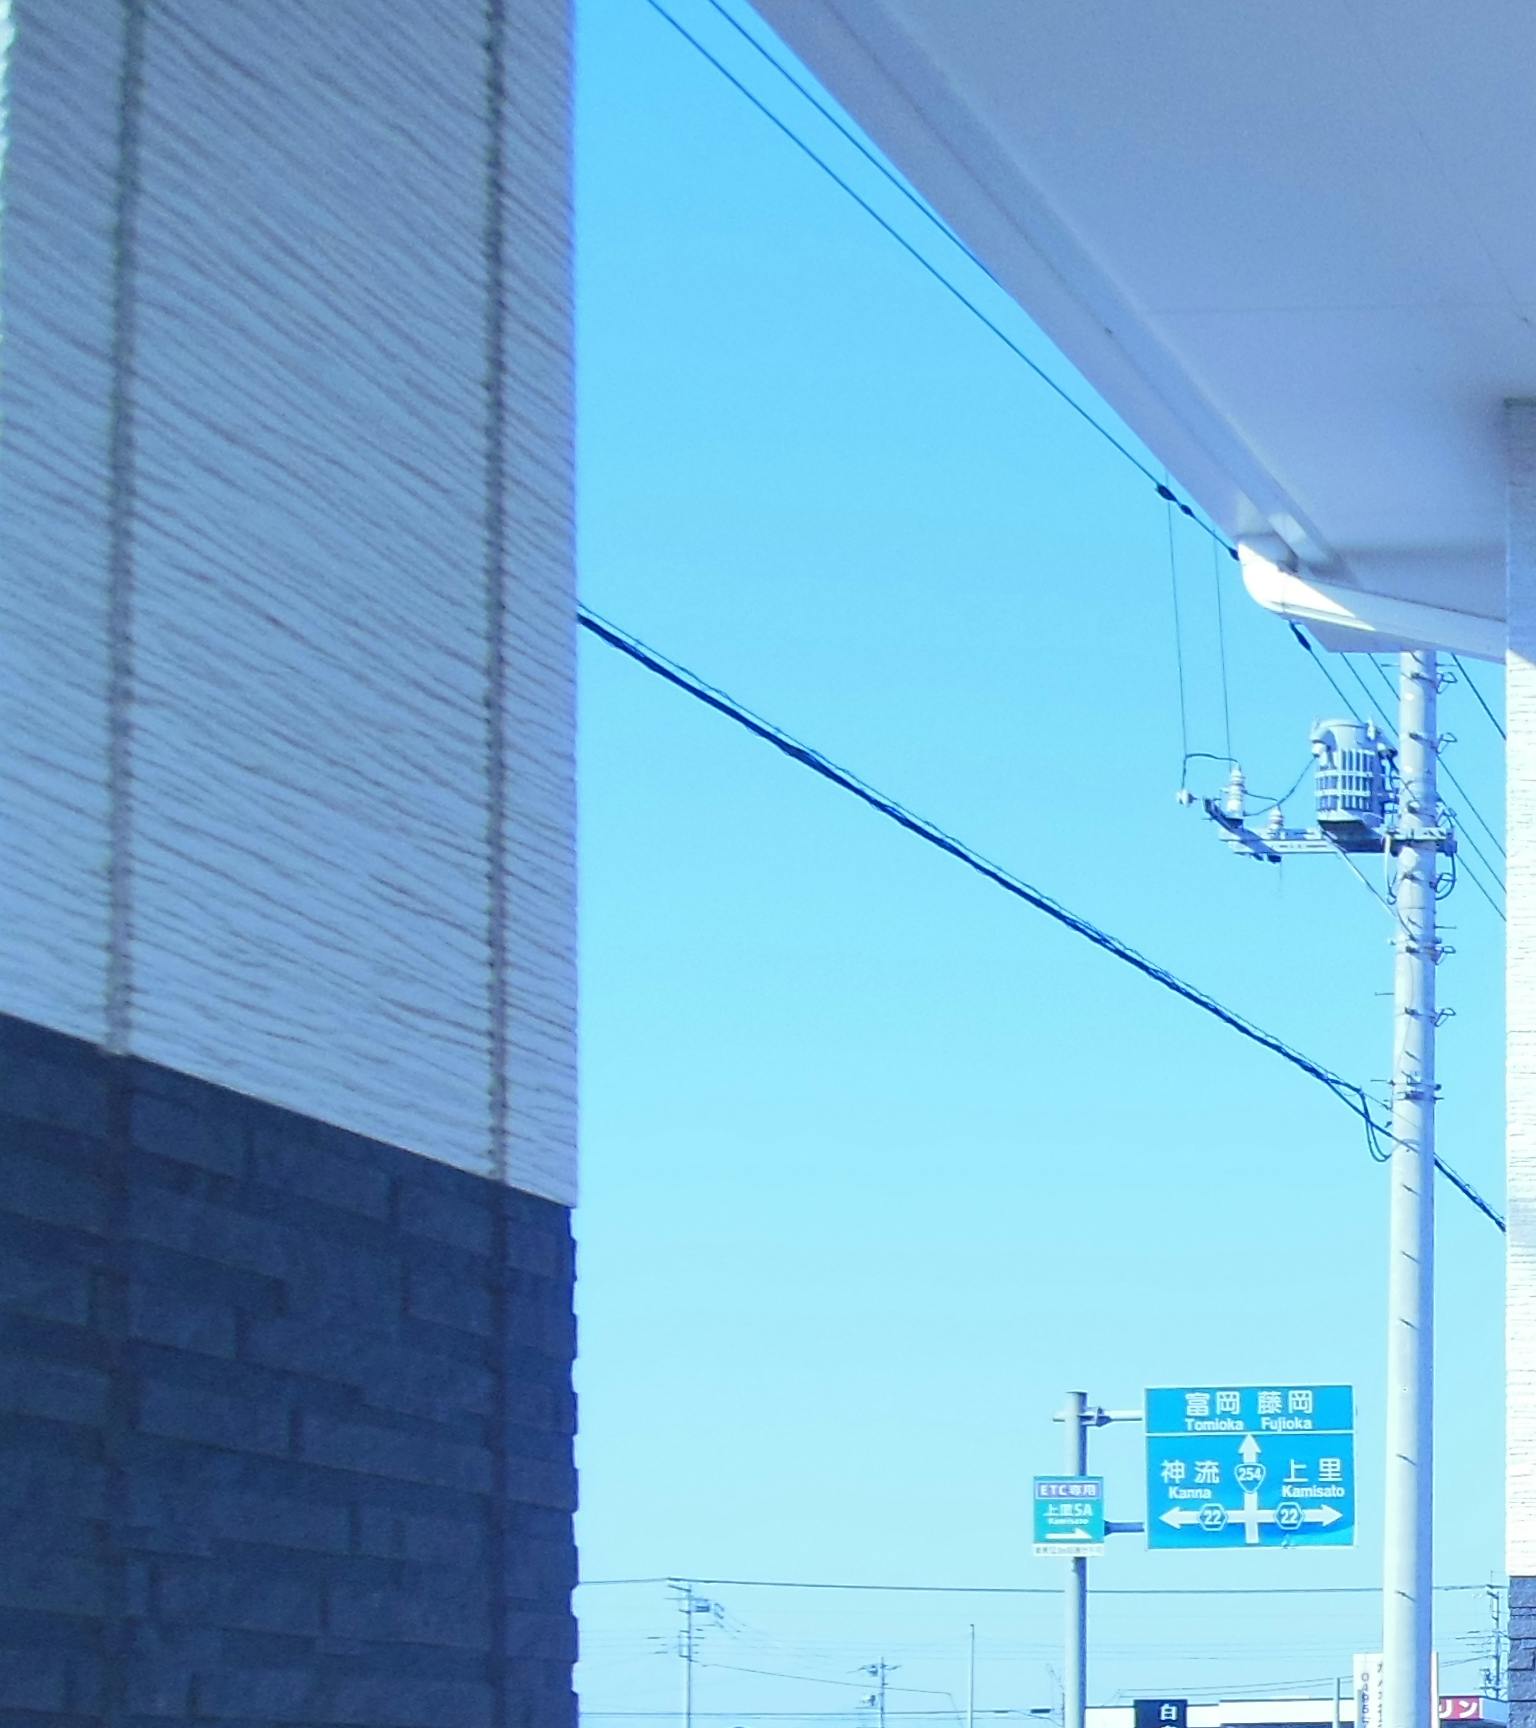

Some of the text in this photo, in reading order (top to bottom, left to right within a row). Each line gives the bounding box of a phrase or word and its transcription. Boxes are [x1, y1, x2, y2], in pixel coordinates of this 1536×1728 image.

[1185, 1390, 1313, 1416] 富岡 藤岡
[1184, 1416, 1312, 1431] Tomioka Fujioka
[1161, 1460, 1220, 1485] 神流
[1238, 1467, 1262, 1482] 254
[1284, 1458, 1343, 1484] 上里
[1168, 1486, 1212, 1499] Kanna
[1281, 1484, 1345, 1498] Kamisato
[1203, 1510, 1221, 1524] 22
[1279, 1508, 1298, 1523] 22
